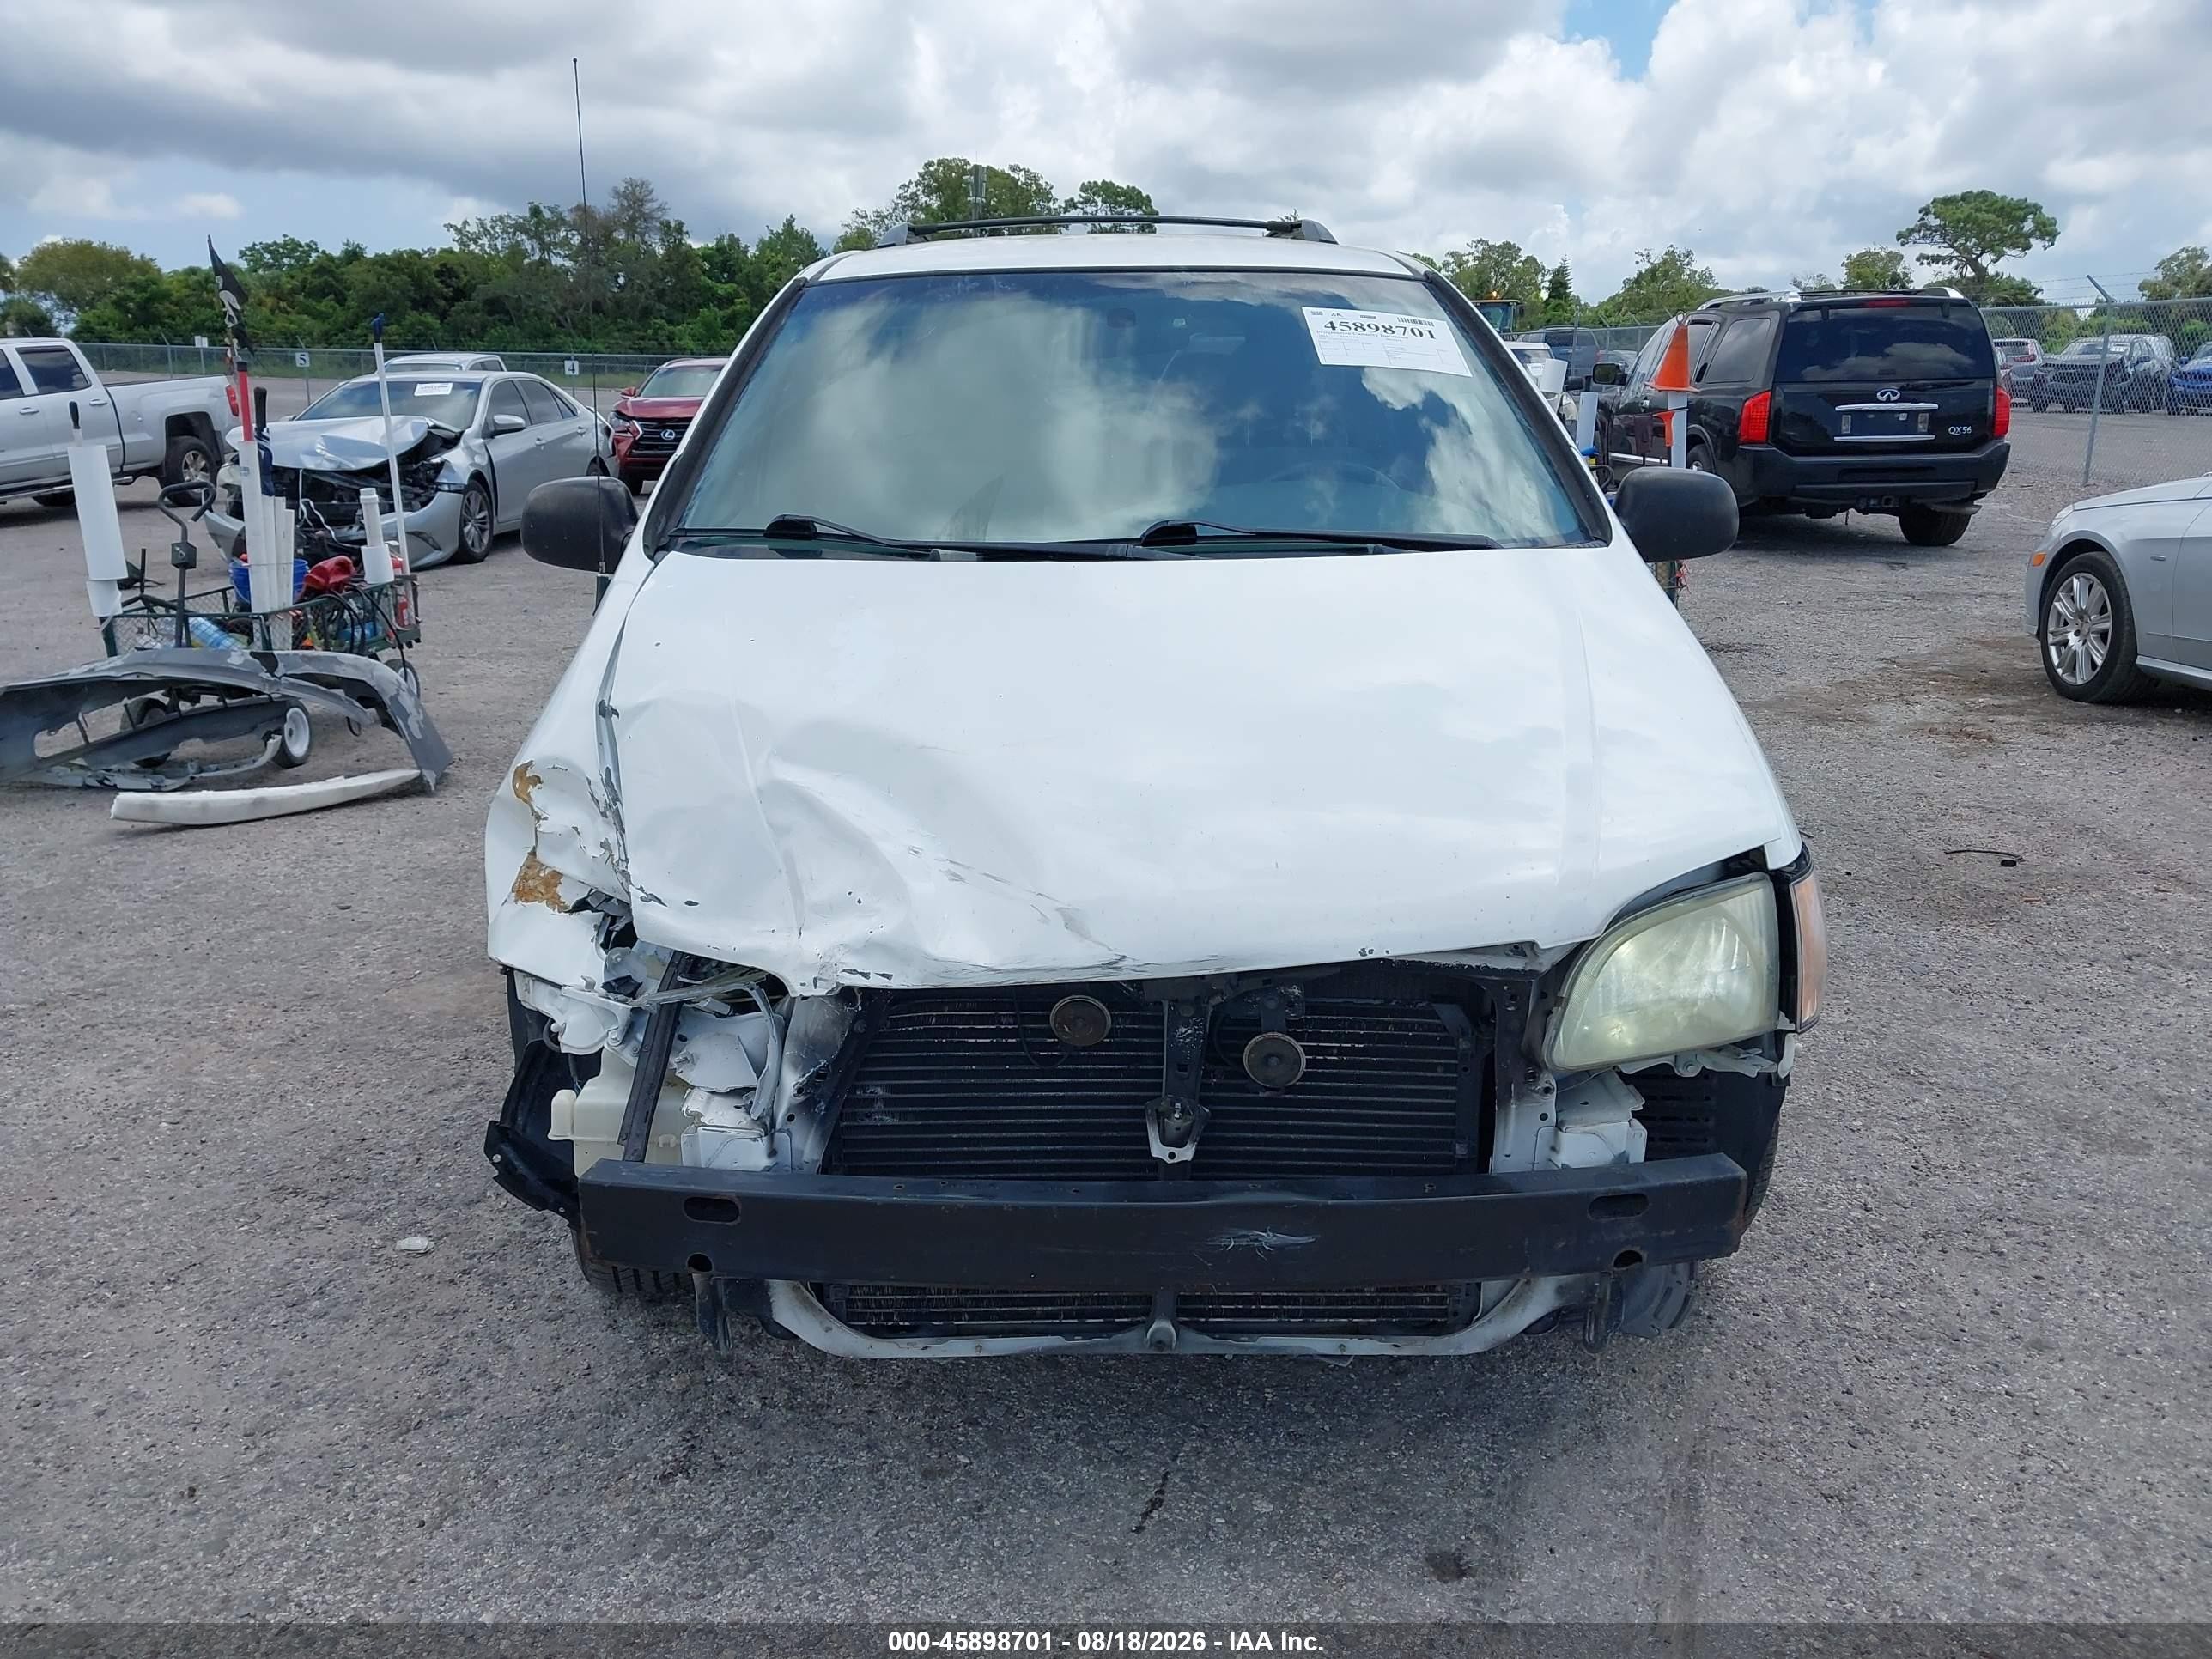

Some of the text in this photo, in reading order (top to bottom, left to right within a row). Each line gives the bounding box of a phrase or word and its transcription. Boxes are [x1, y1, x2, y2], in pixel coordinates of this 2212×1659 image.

[1323, 320, 1437, 340] 45898701
[299, 354, 307, 366] 5
[568, 362, 576, 374] 4
[1948, 425, 1972, 435] QX56
